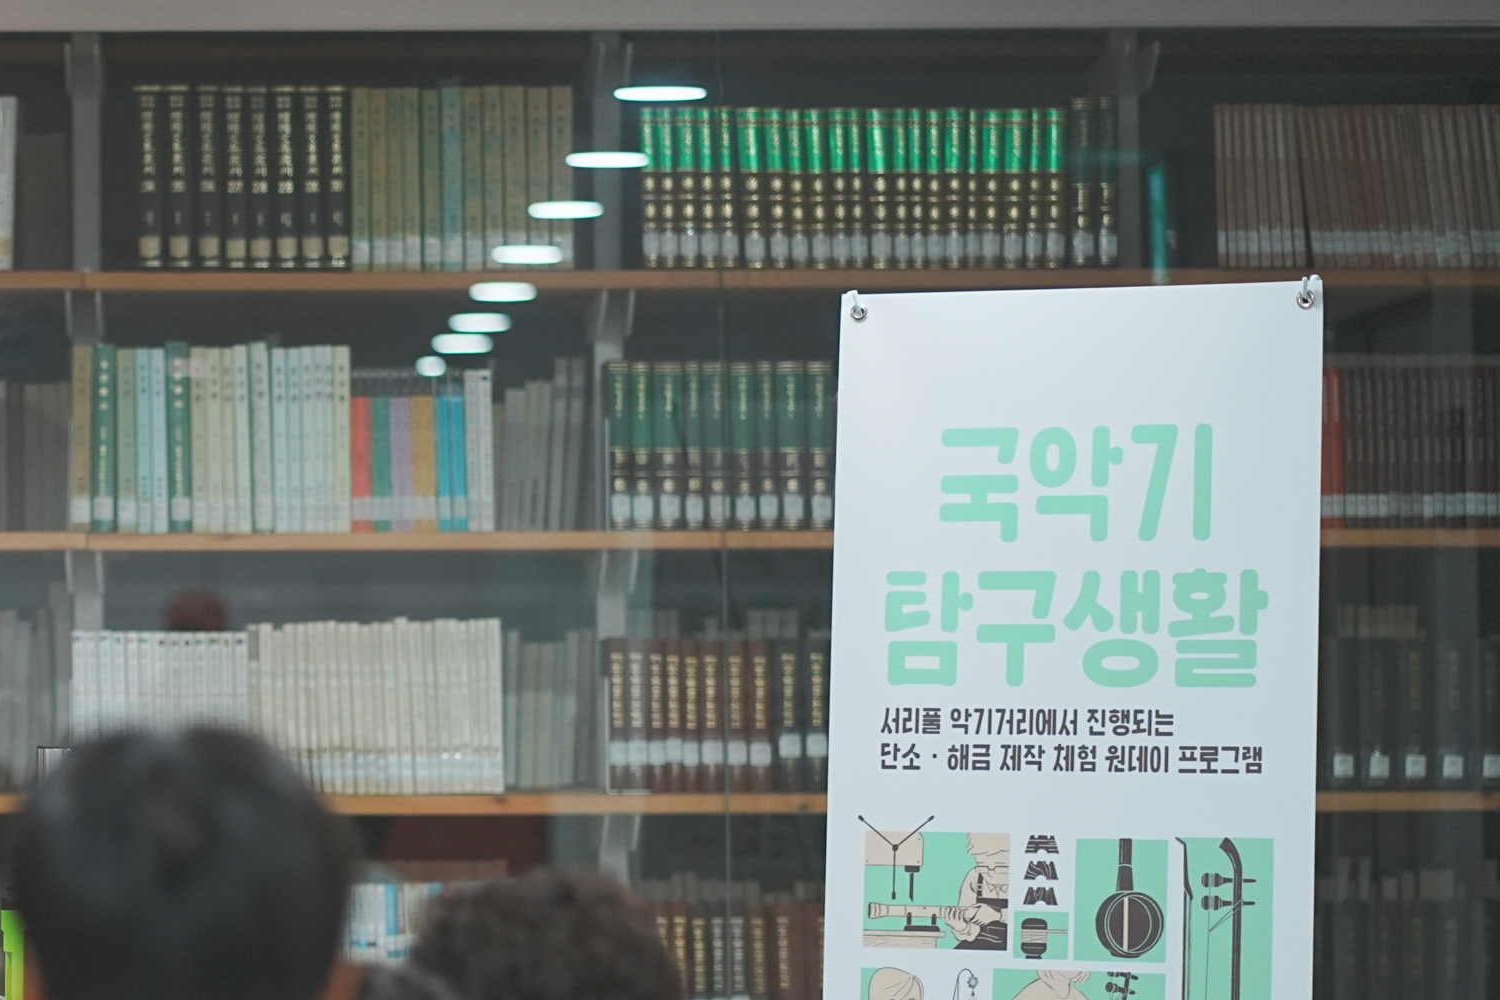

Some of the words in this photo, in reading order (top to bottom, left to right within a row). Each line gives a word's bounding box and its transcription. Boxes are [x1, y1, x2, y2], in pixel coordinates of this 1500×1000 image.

[939, 423, 1213, 543] 국악기
[884, 567, 1269, 688] 탐구생활
[880, 707, 942, 735] 서리풀
[949, 708, 1078, 736] 악기거리에서
[1086, 708, 1174, 737] 진행되는
[880, 743, 921, 771] 단소
[947, 744, 991, 771] 해금
[999, 744, 1046, 772] 제작
[1052, 744, 1097, 773] 체험
[1104, 745, 1170, 774] 원데이
[1178, 746, 1263, 774] 프로그램
